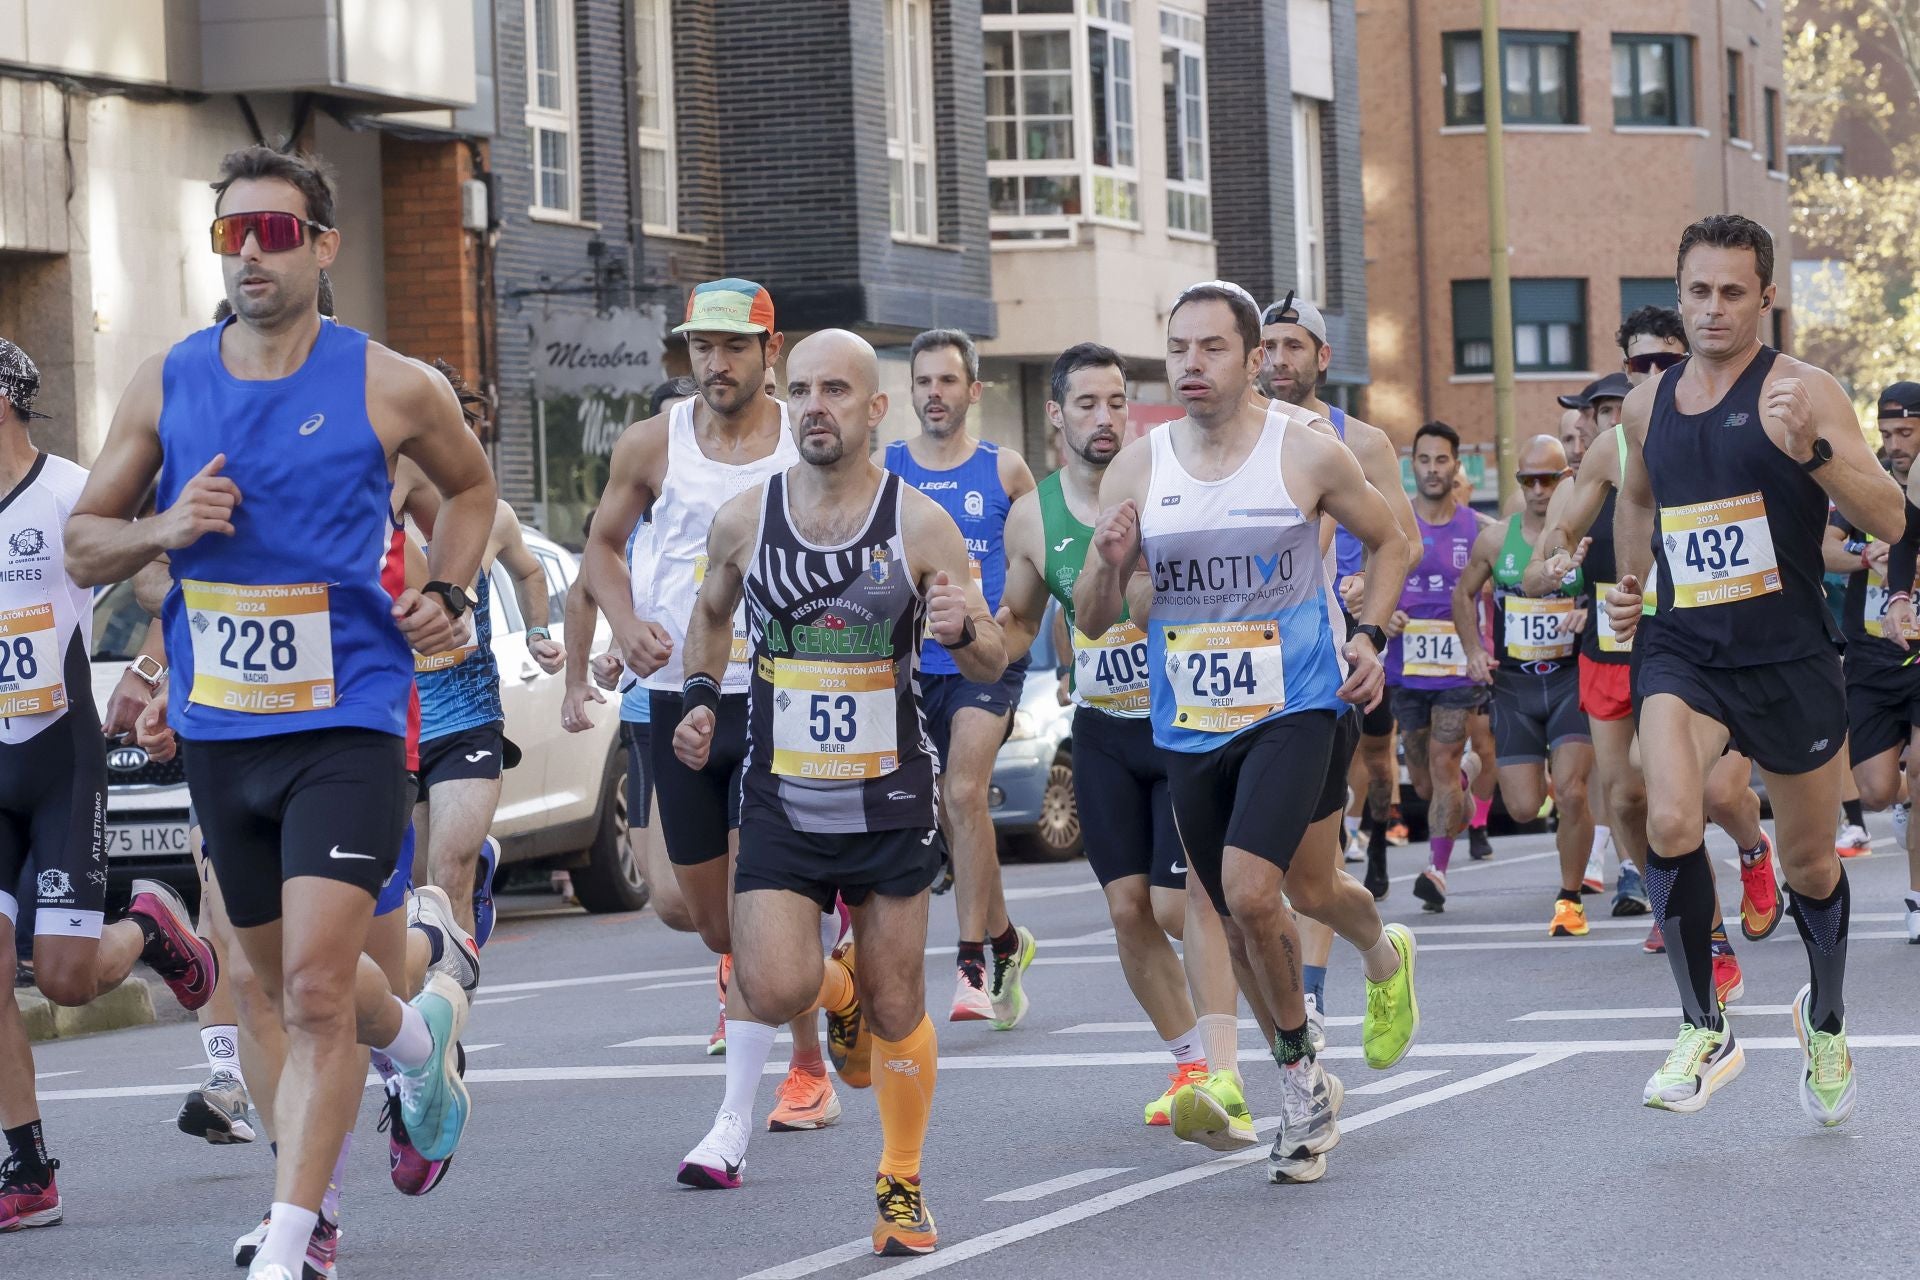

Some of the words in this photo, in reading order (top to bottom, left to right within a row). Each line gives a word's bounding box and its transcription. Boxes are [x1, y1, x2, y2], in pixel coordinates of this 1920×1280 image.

[546, 341, 650, 369] Mirobra
[919, 481, 958, 490] LEGEA
[1698, 500, 1734, 513] MARATÓN
[1735, 495, 1760, 506] AVILÉS
[1696, 513, 1720, 525] 2024
[1686, 525, 1749, 573] 432
[1155, 549, 1293, 593] CEACTIVO
[1711, 570, 1729, 580] SORIN
[239, 584, 289, 598] MARATÓN
[291, 585, 324, 597] AVILÉS
[1152, 594, 1200, 606] CONDICIÓN
[1203, 592, 1256, 605] ESPECTRO
[1257, 584, 1295, 600] AUTISTA
[1696, 582, 1752, 603] avilés
[26, 605, 50, 618] AVILÉS
[236, 601, 266, 613] 2024
[790, 597, 874, 621] RESTAURANTE
[1209, 621, 1249, 634] MARATÓN
[1250, 622, 1276, 632] AVILÉS
[1520, 615, 1559, 640] 153
[217, 616, 297, 672] 228
[791, 618, 894, 657] CEREZAL
[1105, 635, 1126, 645] 2024
[1206, 637, 1231, 646] 2024
[1416, 635, 1454, 660] 314
[800, 665, 822, 674] MEDIA
[824, 663, 867, 675] MARATÓN
[868, 662, 890, 673] AVILÉS
[1095, 643, 1150, 687] 409
[1187, 651, 1257, 697] 254
[243, 672, 268, 683] NACHO
[819, 678, 847, 688] 2024
[223, 690, 296, 709] avilés
[1210, 697, 1234, 707] SPEEDY
[809, 694, 857, 742] 53
[1199, 710, 1255, 729] avilés
[820, 743, 846, 752] BELVER
[111, 752, 140, 766] KIA
[800, 760, 867, 777] avilés
[92, 791, 102, 863] ATLETISMO
[142, 828, 185, 851] HXC
